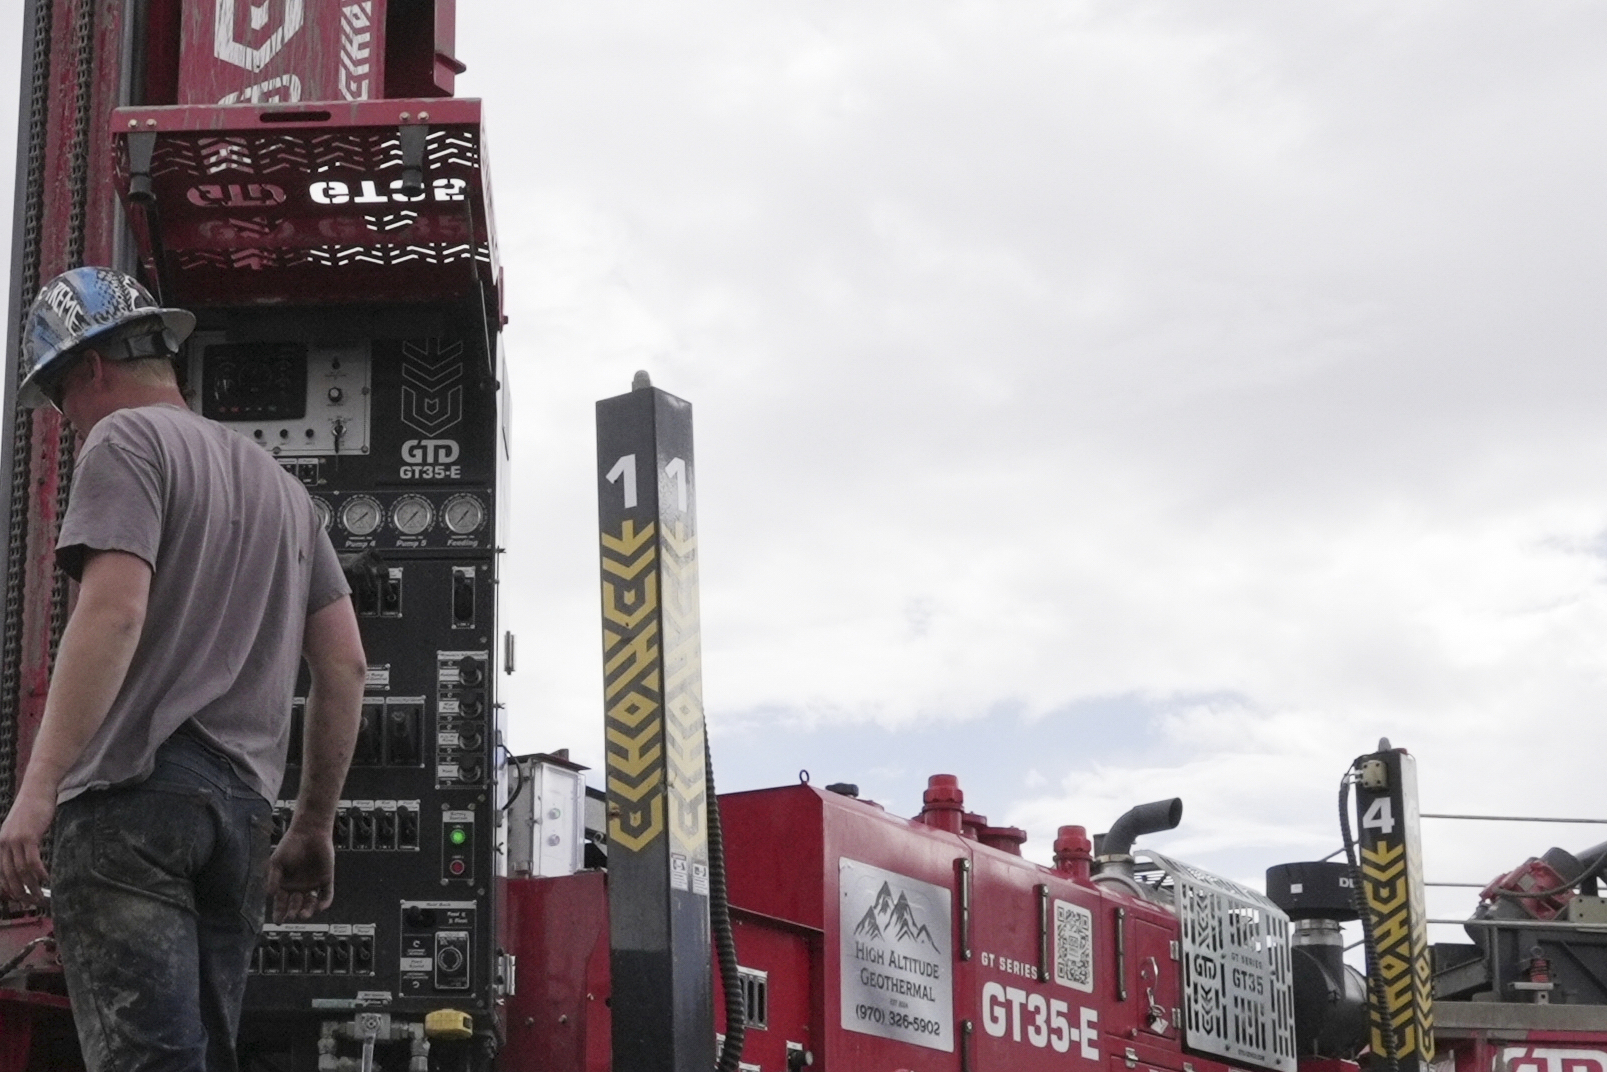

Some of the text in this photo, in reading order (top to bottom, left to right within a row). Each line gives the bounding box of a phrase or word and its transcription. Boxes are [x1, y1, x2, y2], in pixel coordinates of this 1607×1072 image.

[401, 439, 460, 464] GTD
[399, 465, 461, 480] GT35-E
[606, 454, 638, 509] 1
[665, 457, 688, 513] 1
[345, 540, 368, 549] Pump
[396, 540, 419, 549] Pump
[447, 539, 478, 548] Feeding
[1362, 796, 1395, 834] 4
[855, 941, 940, 980] HIGH ALTITUDE
[981, 951, 1038, 980] GT SERIES
[860, 967, 936, 1003] GEOTHERMAL
[1232, 967, 1264, 996] GT35
[855, 1004, 941, 1037] (970) 326-5902
[981, 981, 1100, 1061] GT35-E
